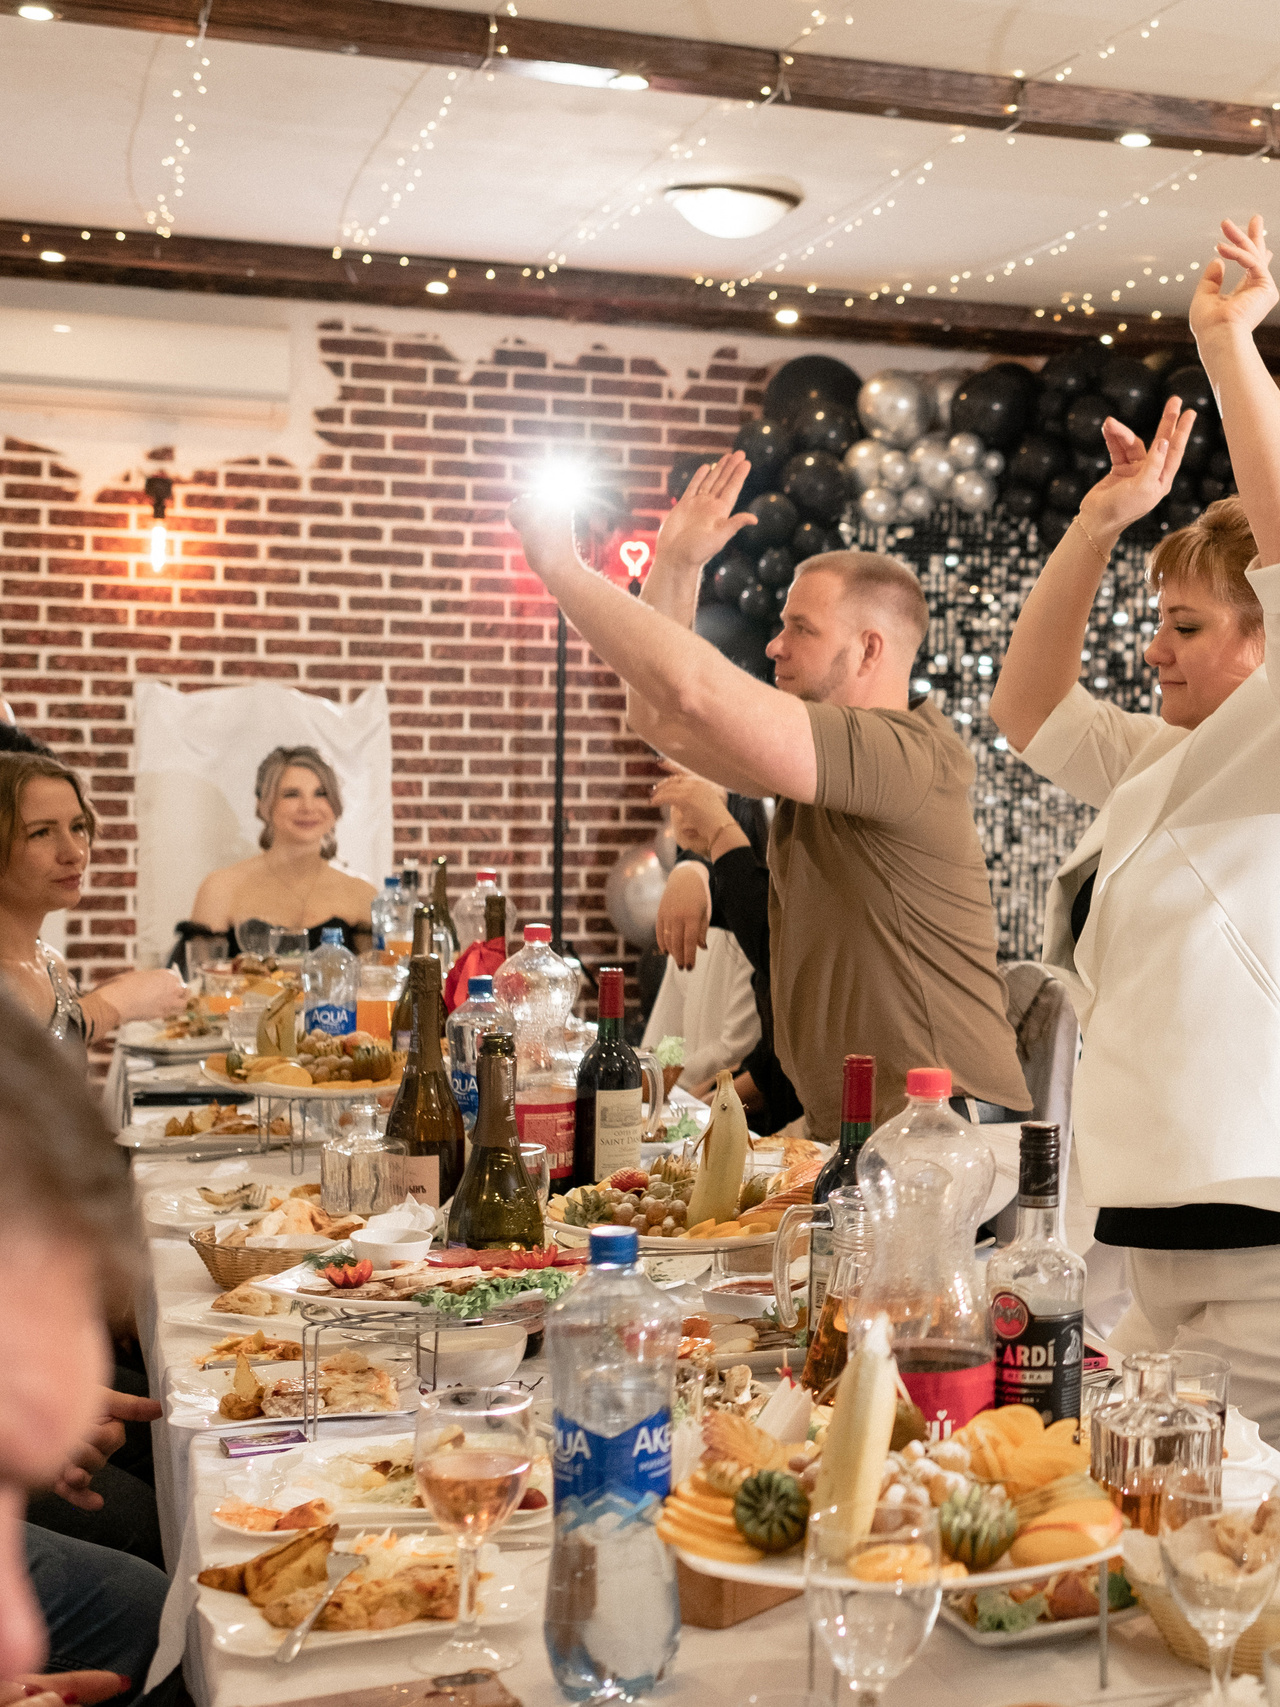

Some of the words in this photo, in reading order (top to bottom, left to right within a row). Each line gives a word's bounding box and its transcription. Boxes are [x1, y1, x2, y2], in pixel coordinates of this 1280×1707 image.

[312, 1009, 349, 1025] AQUA
[451, 1077, 479, 1096] QUA
[600, 1137, 625, 1146] SAINT
